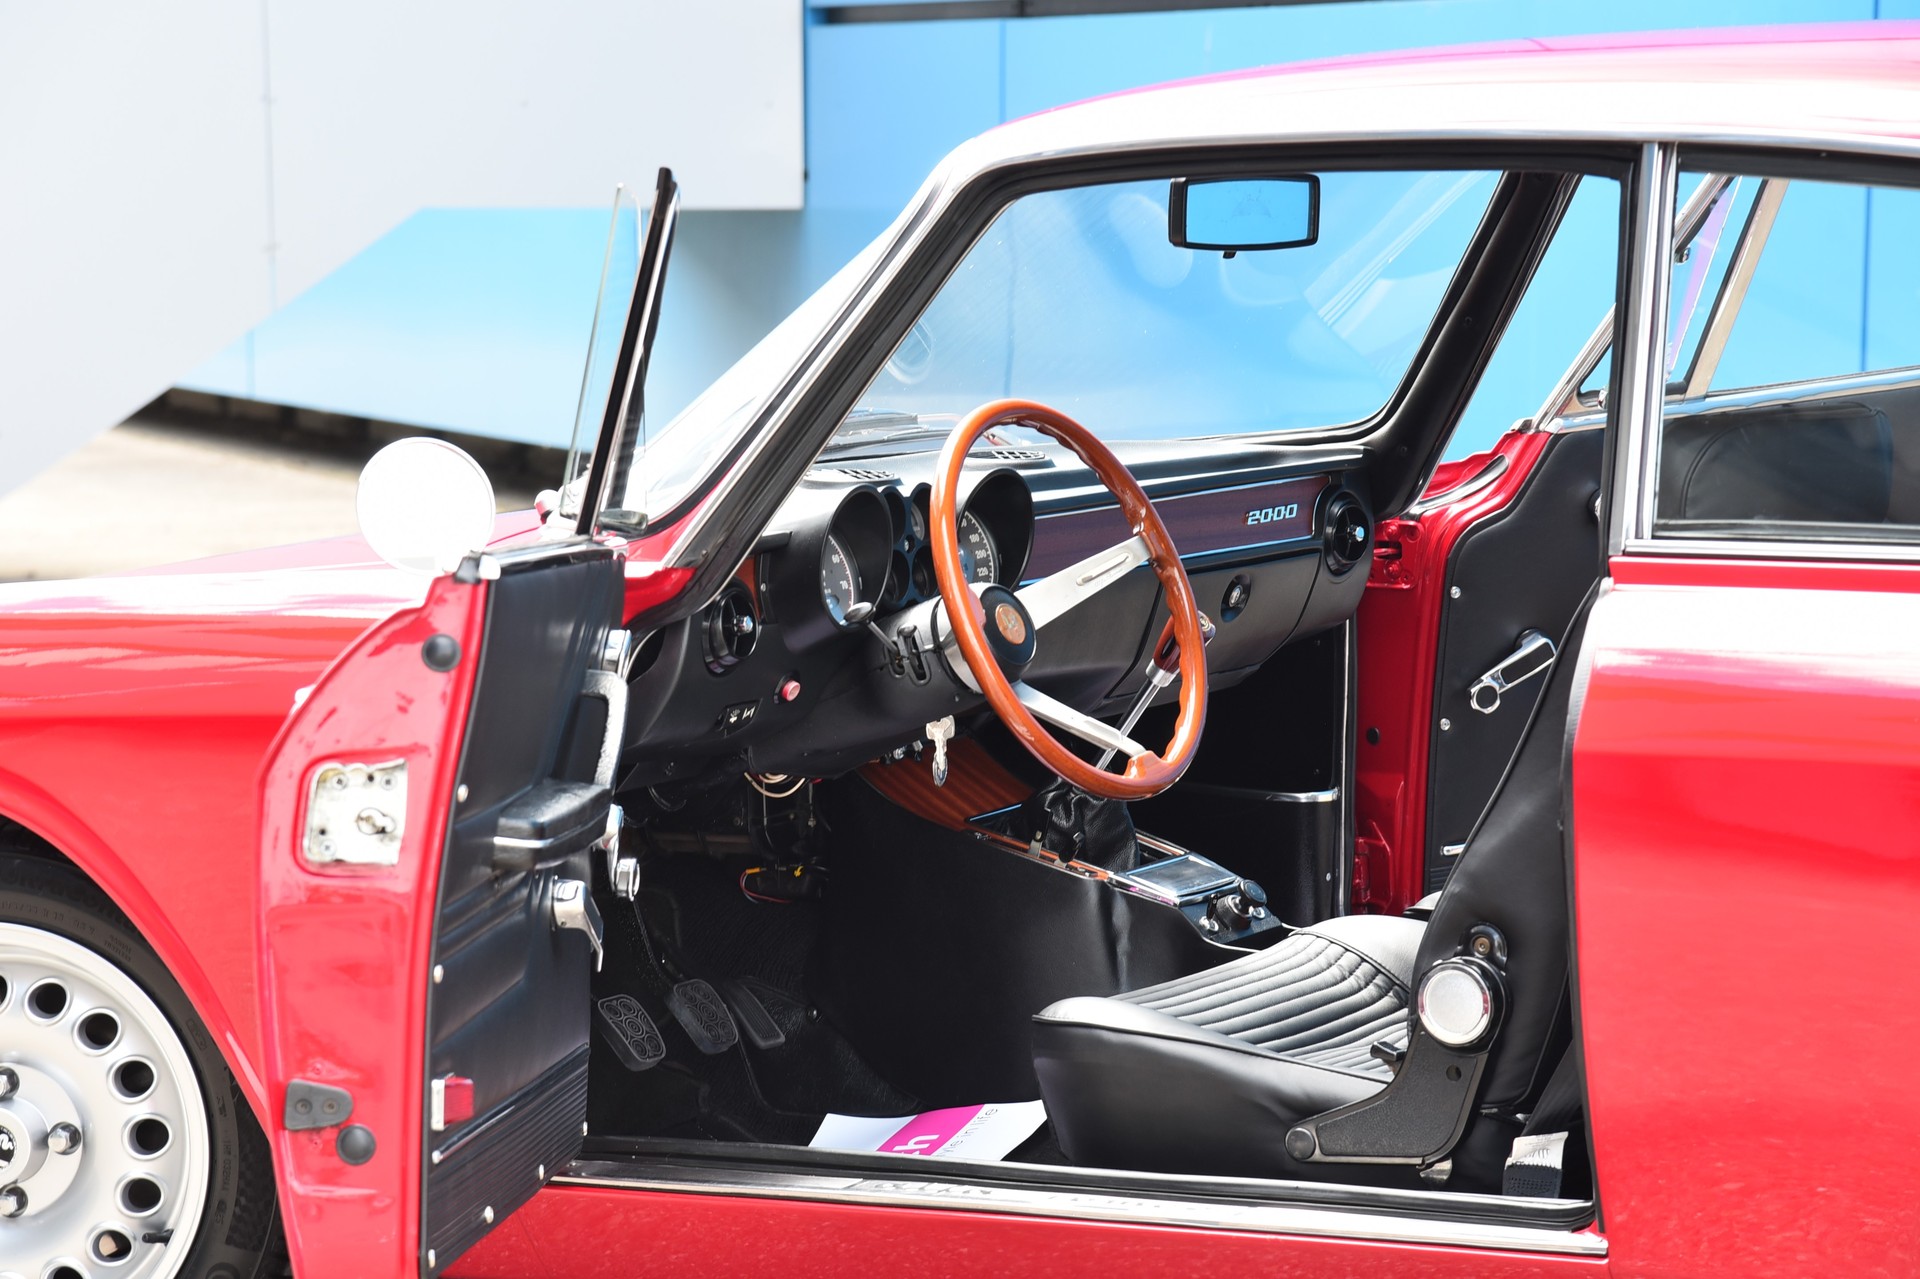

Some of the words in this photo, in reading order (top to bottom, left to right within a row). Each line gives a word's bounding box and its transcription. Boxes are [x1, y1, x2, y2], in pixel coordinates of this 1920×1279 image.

[1247, 503, 1298, 526] 2000
[969, 533, 980, 543] 180
[832, 553, 840, 564] 60
[975, 549, 987, 560] 200
[977, 566, 989, 577] 220
[840, 580, 849, 590] 70
[892, 1134, 940, 1155] h
